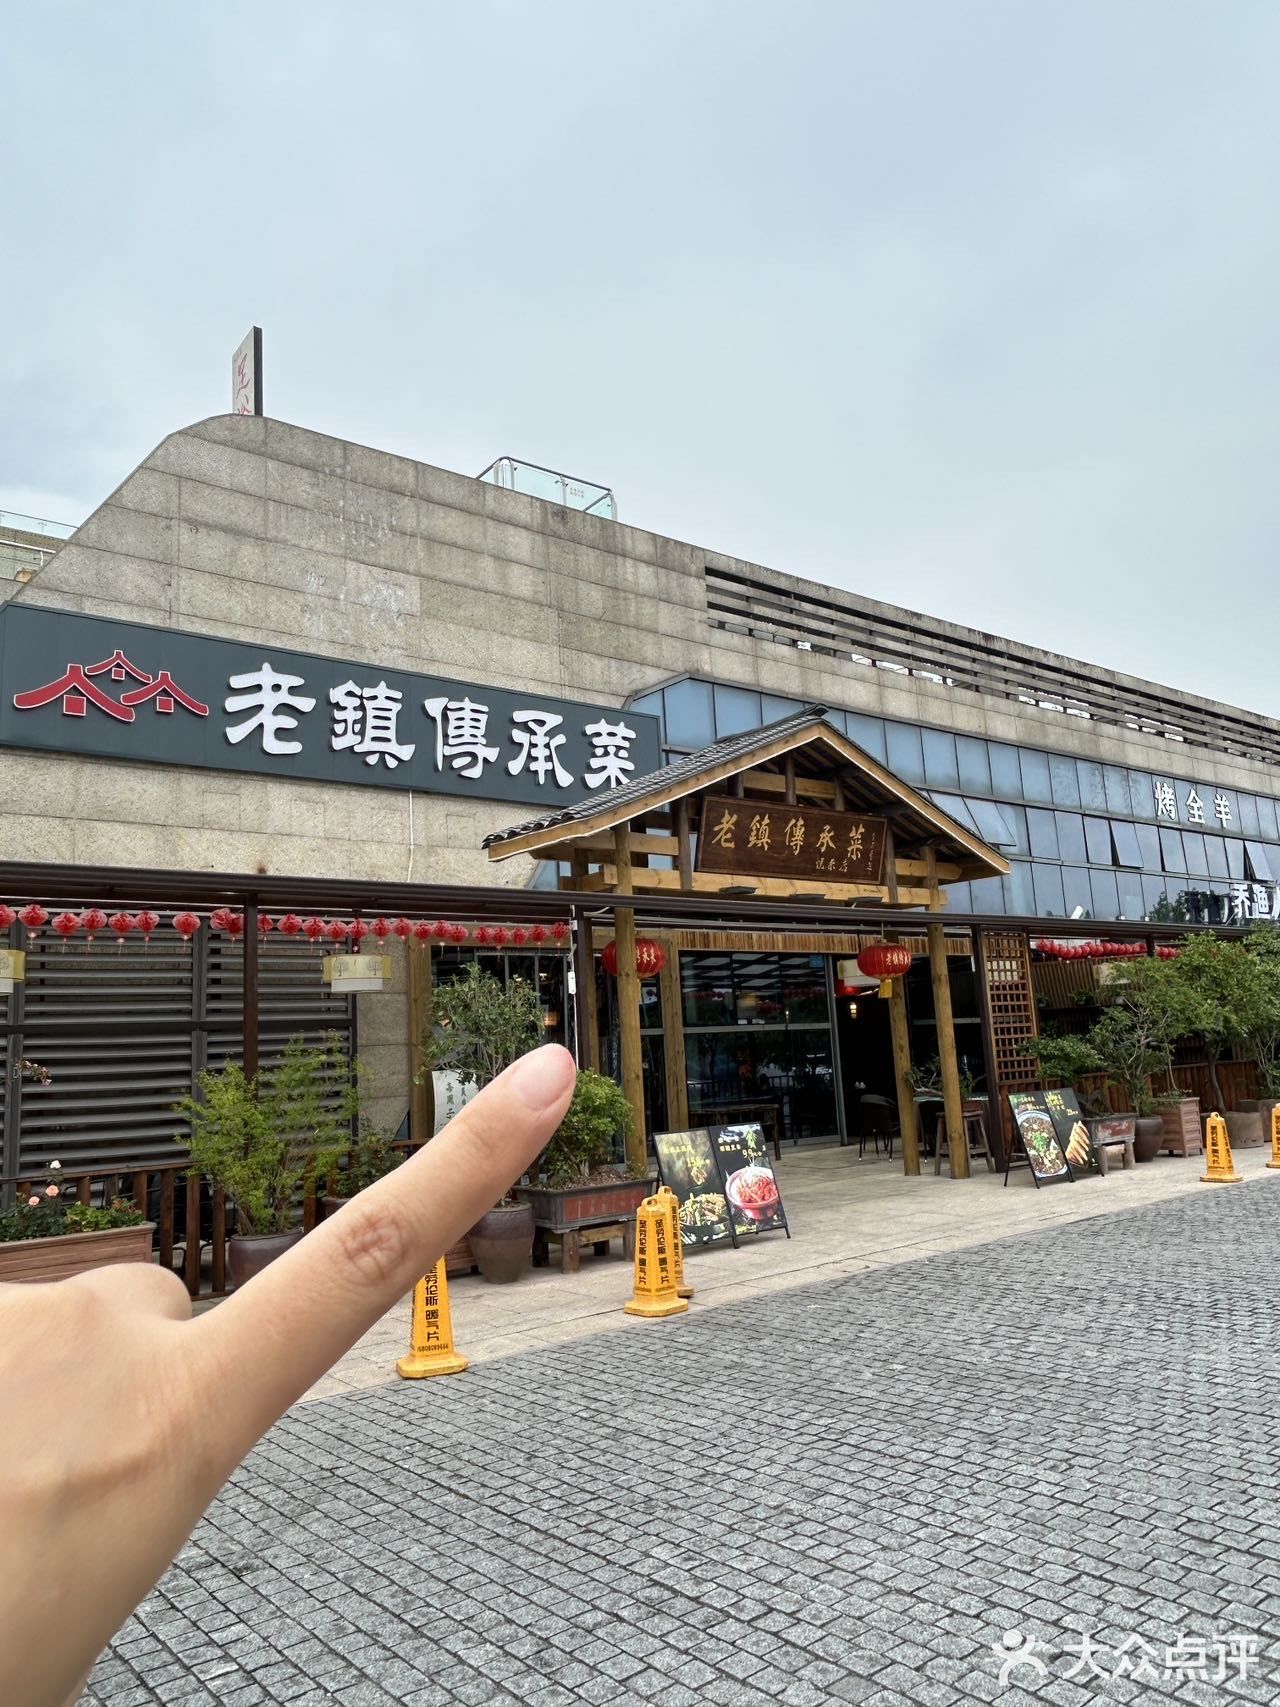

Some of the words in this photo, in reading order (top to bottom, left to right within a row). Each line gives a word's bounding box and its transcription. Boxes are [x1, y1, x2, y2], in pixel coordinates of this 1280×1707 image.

[224, 662, 638, 790] 老鎮傳承菜
[1154, 781, 1233, 828] 烤全羊
[711, 809, 866, 862] 老鎮傳承菜
[425, 1309, 440, 1342] 暖气片
